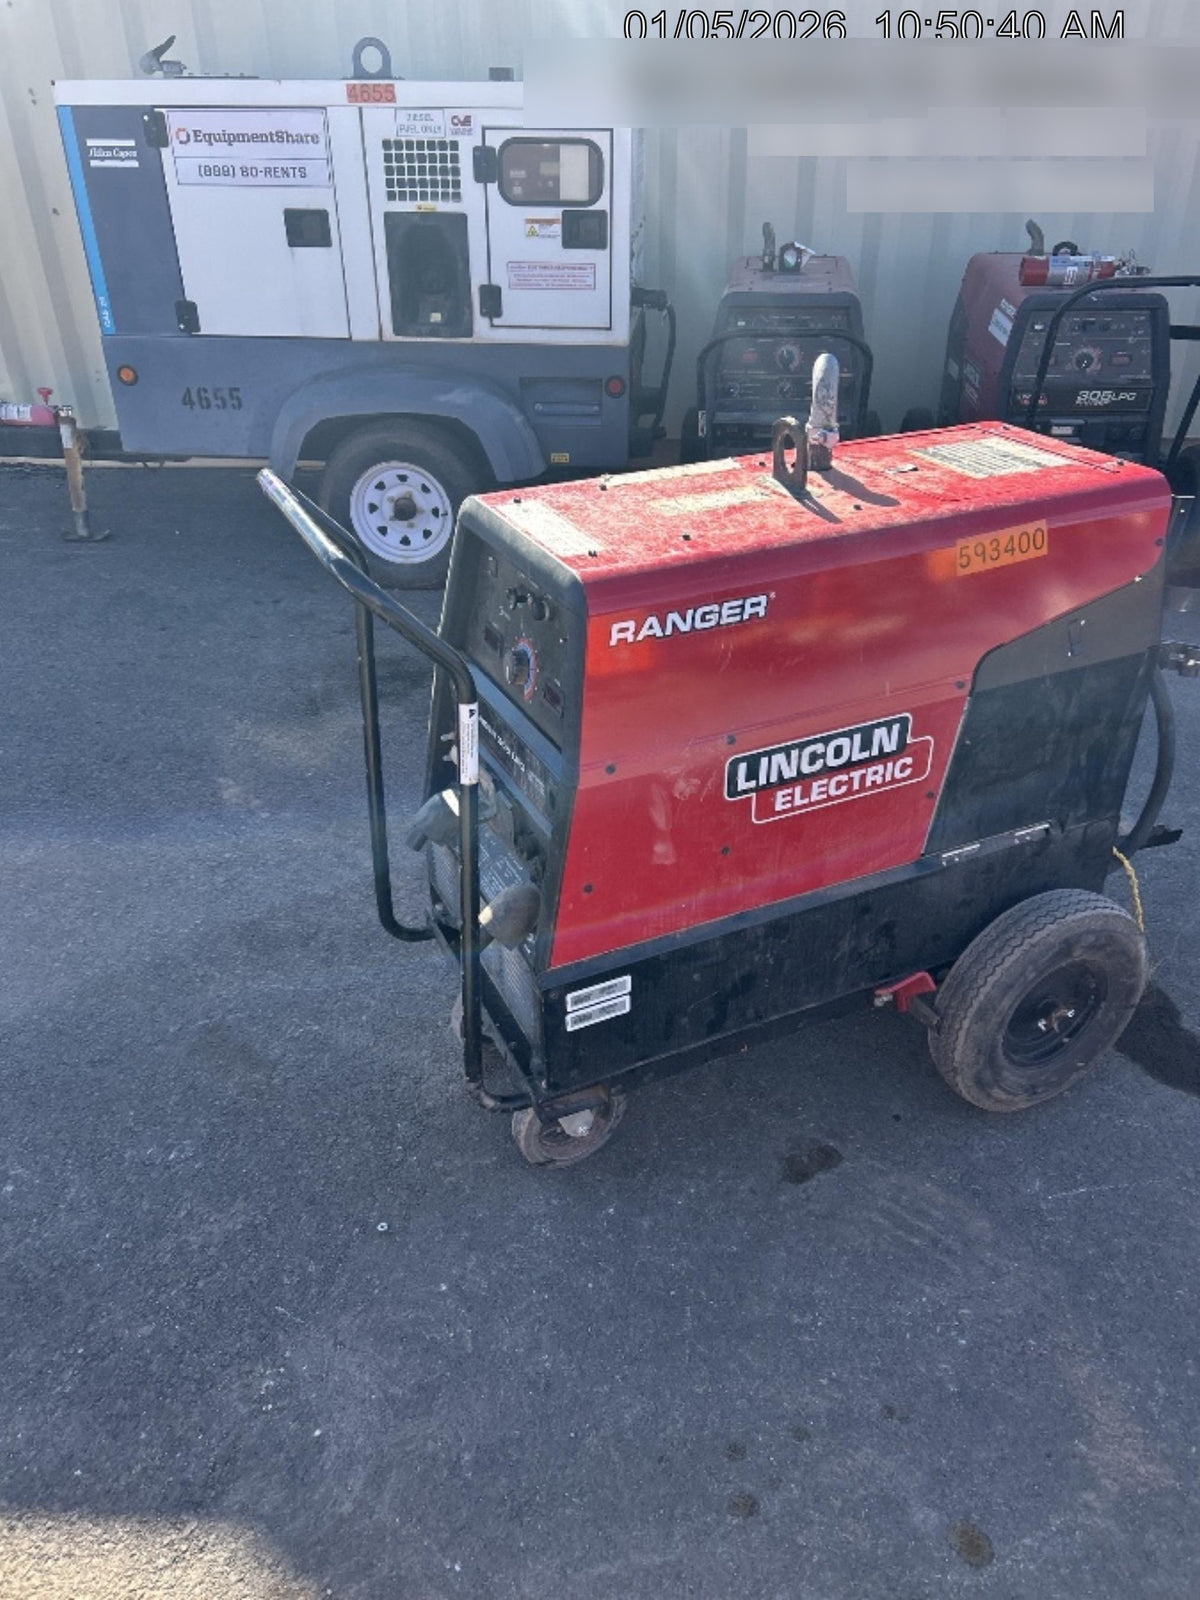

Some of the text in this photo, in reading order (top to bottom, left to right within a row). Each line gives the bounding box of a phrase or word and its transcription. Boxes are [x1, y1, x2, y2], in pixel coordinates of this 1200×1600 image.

[346, 83, 396, 102] 4655
[192, 129, 320, 147] EquipmentShare
[181, 387, 243, 410] 4655
[958, 527, 1047, 571] 593400
[609, 594, 768, 647] RANGER
[736, 722, 901, 792] LINCOLN
[774, 756, 914, 812] ELECTRIC
